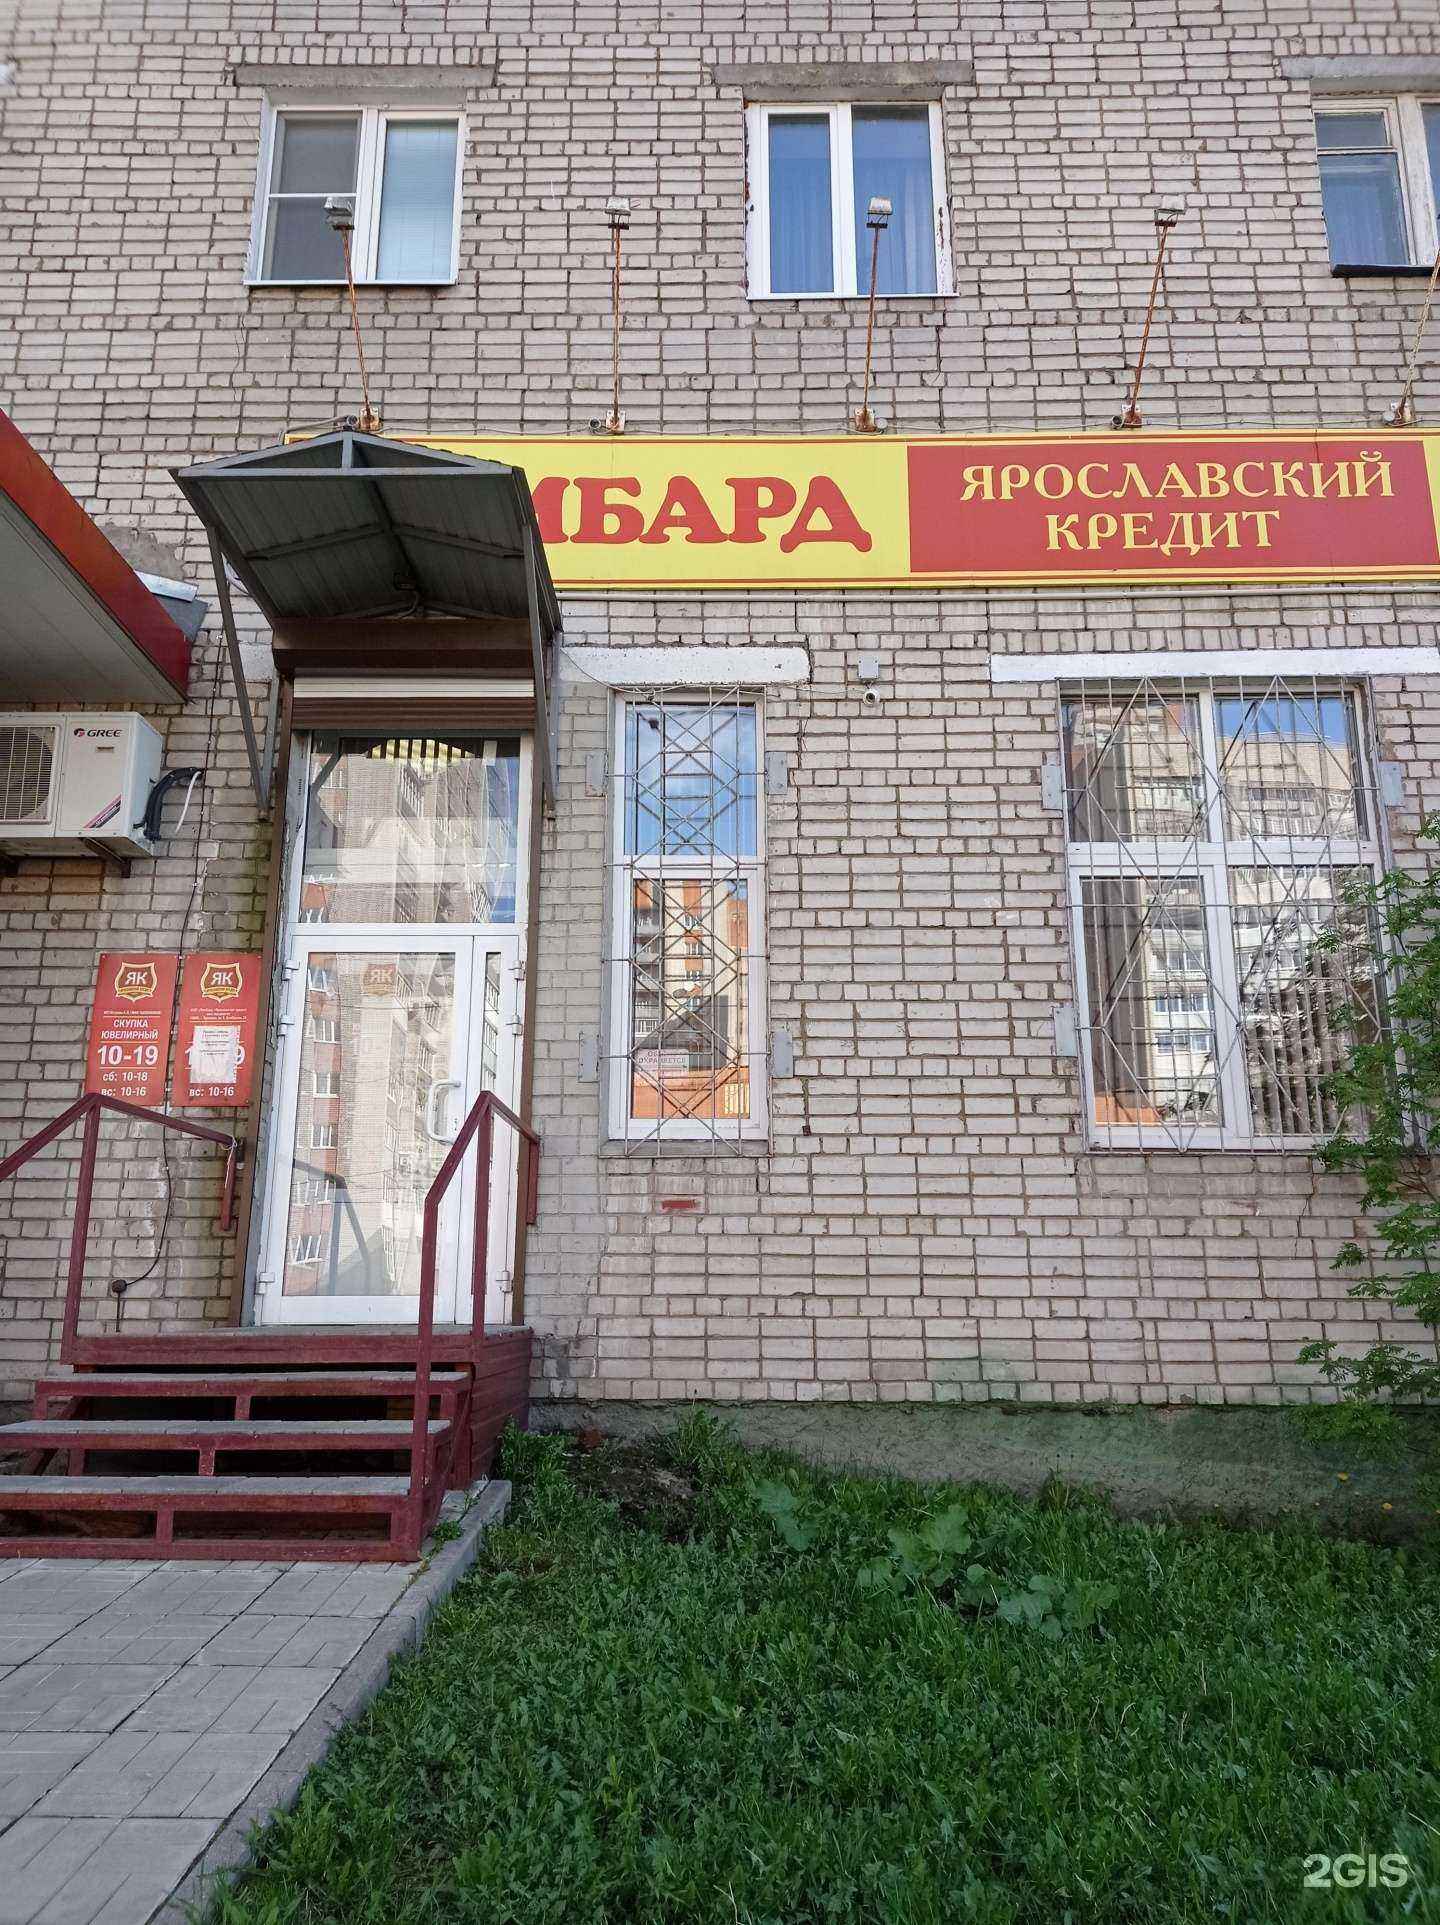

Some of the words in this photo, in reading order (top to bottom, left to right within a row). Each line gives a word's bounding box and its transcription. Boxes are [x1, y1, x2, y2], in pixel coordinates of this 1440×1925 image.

[960, 450, 1394, 500] ЯРОСЛАВСКИЙ
[1045, 510, 1281, 556] КРЕДИТ
[87, 729, 122, 738] GREE
[126, 972, 148, 985] ЯК
[211, 972, 233, 985] ЯК
[113, 1019, 149, 1028] СКУПКА
[101, 1029, 159, 1039] ЮВЕЛИРНЫЙ
[97, 1045, 159, 1066] 10-19
[120, 1086, 147, 1097] 10-16
[189, 1087, 205, 1097] вс:
[208, 1086, 235, 1097] 10-16
